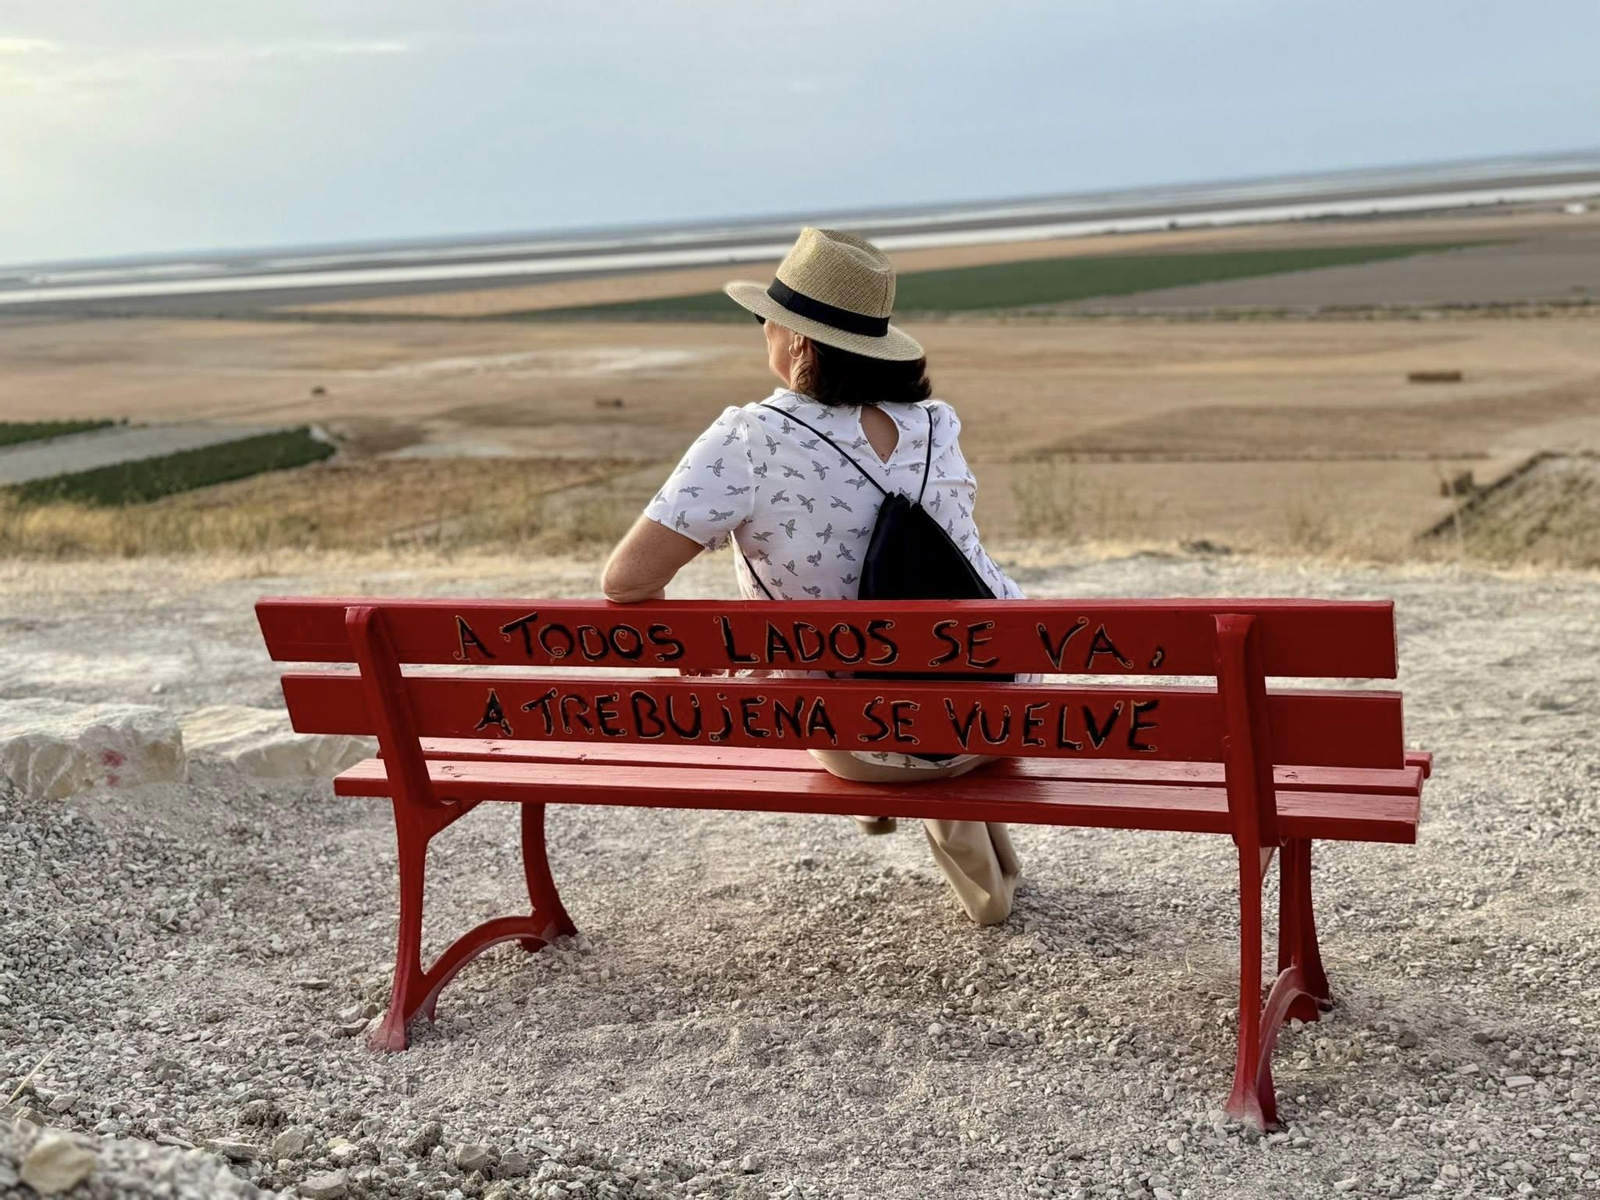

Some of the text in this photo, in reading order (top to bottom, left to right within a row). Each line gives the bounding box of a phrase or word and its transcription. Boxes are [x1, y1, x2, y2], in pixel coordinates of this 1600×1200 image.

[453, 615, 496, 661] A
[500, 612, 686, 662] TODOS
[713, 615, 899, 665] LADOS
[928, 619, 999, 669] SE
[474, 688, 513, 737] A
[858, 697, 921, 745] SE
[944, 698, 1159, 752] VUELVE
